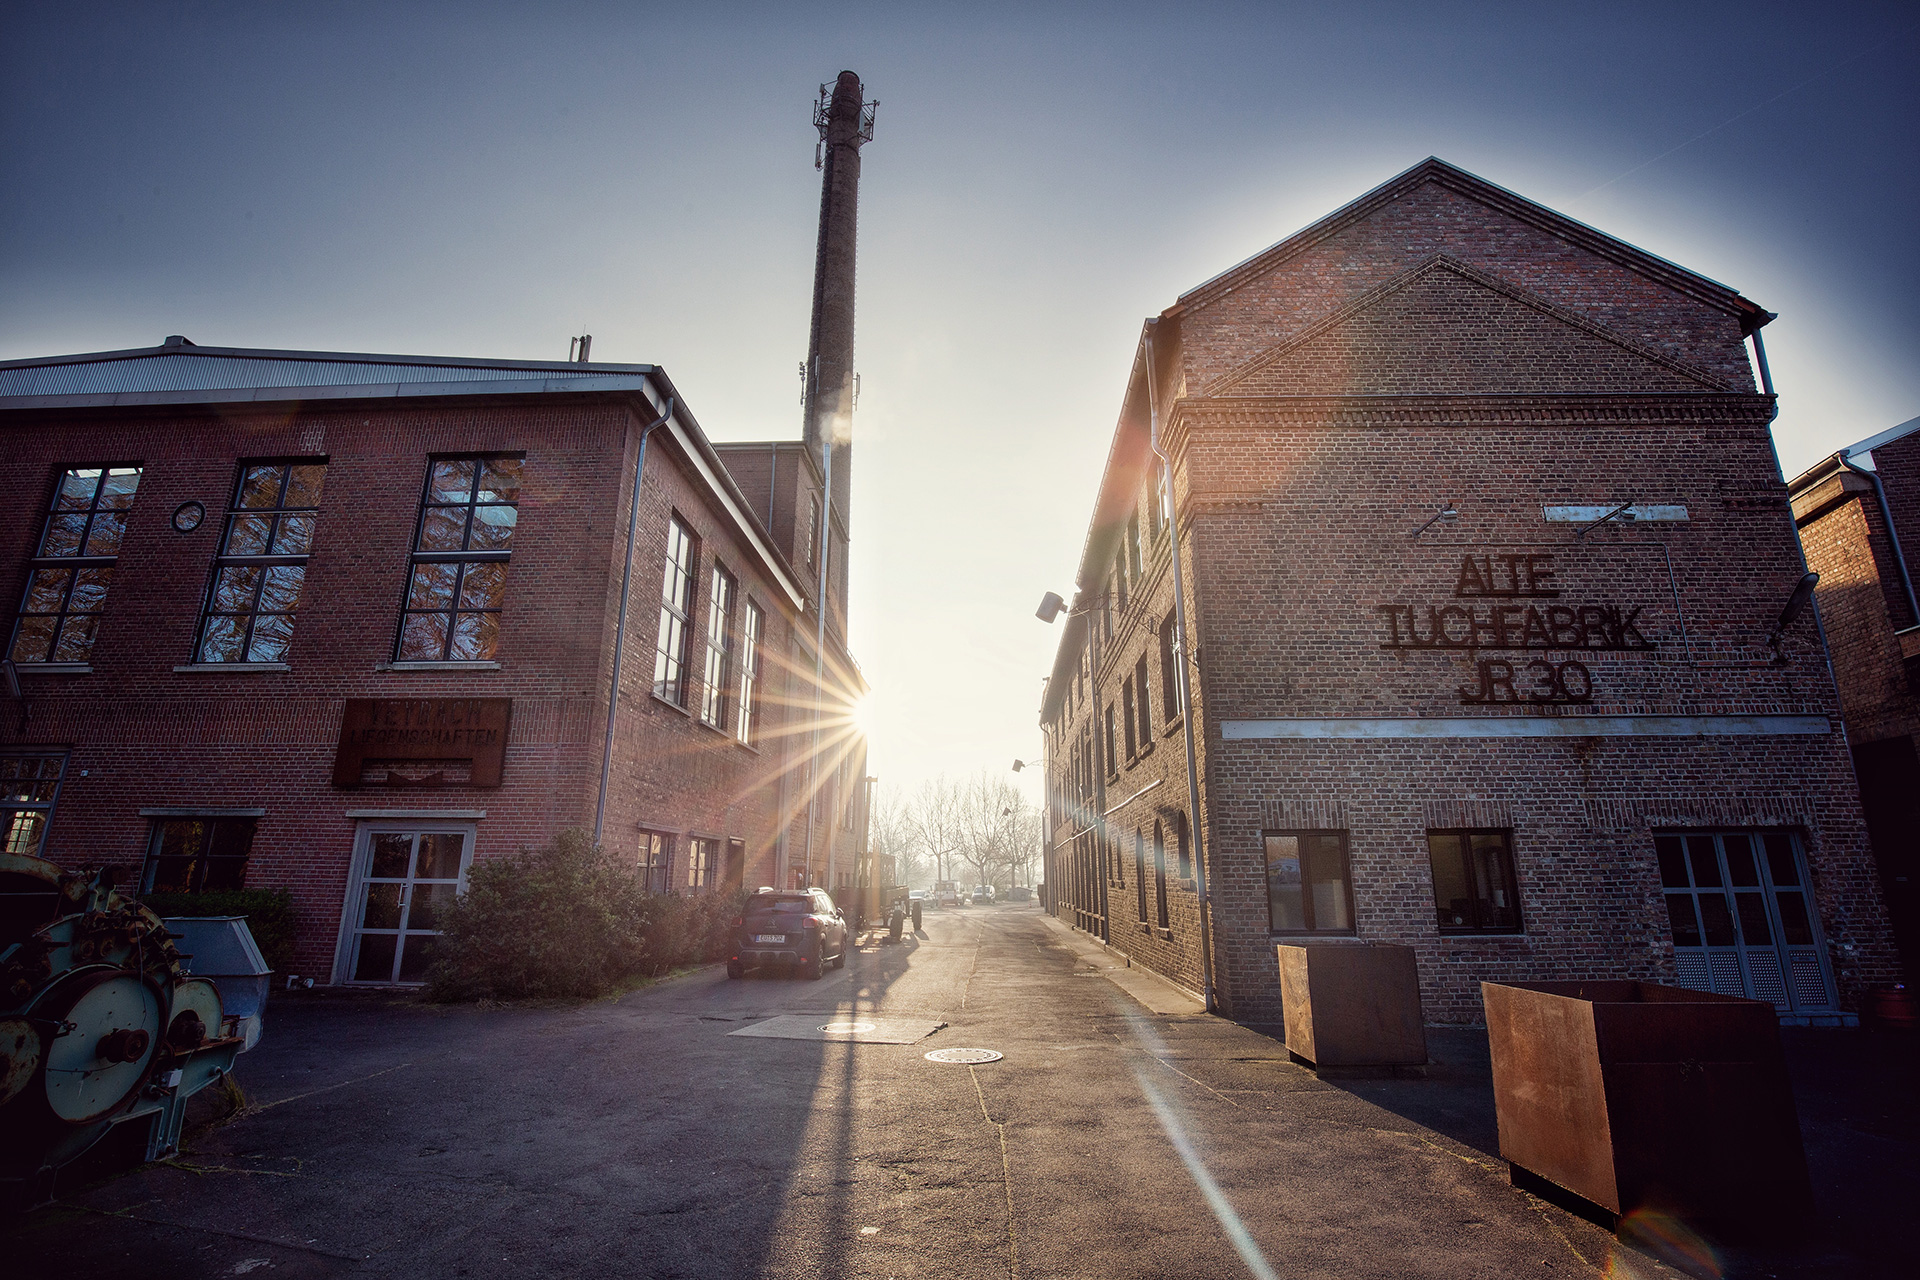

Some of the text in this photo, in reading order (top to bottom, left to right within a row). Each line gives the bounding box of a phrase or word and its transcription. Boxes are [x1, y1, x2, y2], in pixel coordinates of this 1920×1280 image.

[1456, 554, 1559, 596] ALTE
[1380, 605, 1653, 649] TUCHFABRIK
[1460, 660, 1593, 702] JR 30
[350, 729, 497, 745] LIEGENSCHAFTEN
